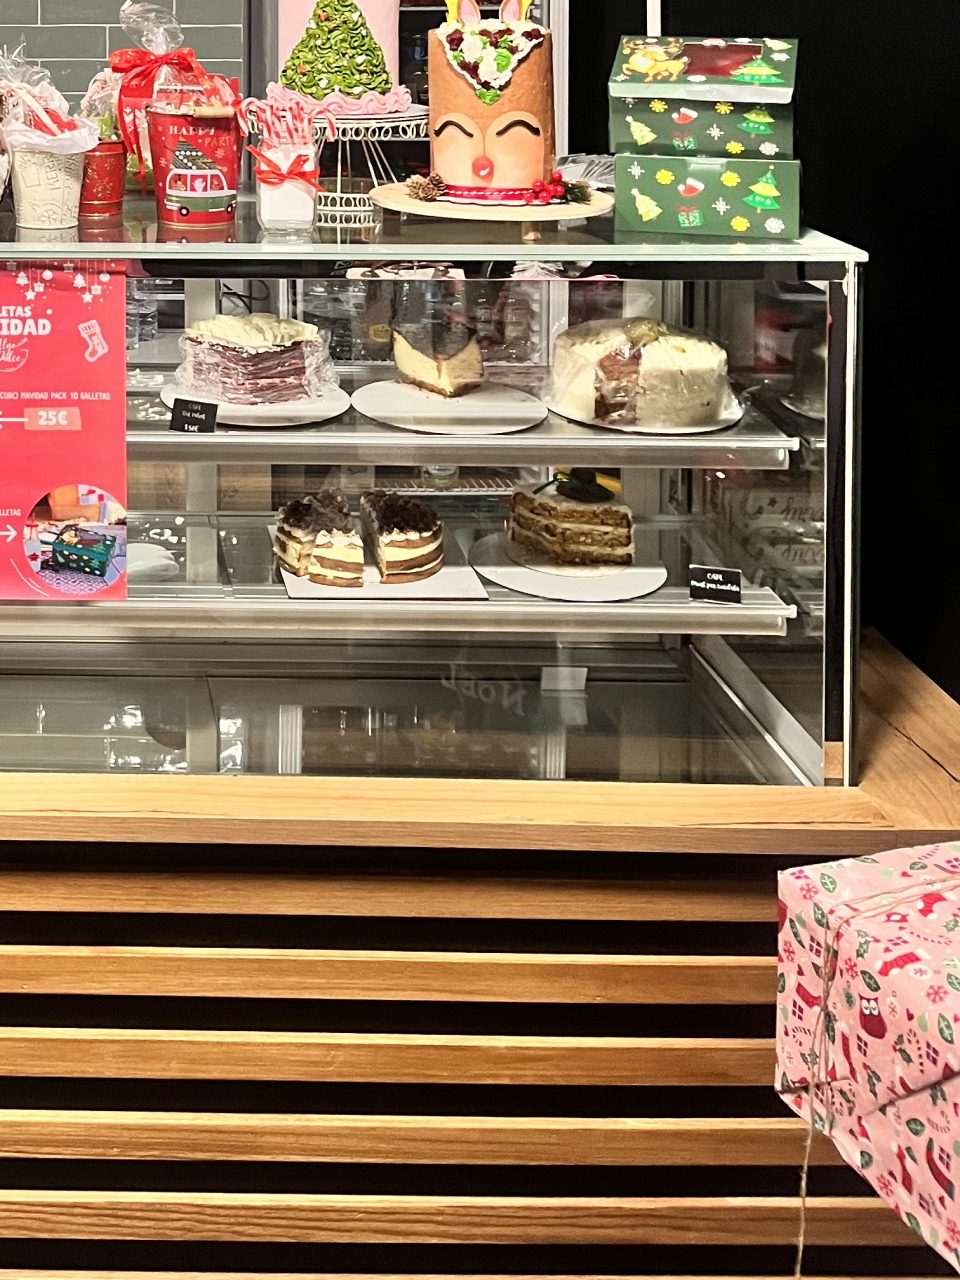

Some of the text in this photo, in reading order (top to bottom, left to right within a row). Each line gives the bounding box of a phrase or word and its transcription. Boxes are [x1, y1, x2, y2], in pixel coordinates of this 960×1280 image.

[168, 125, 215, 136] HAPPY
[0, 391, 111, 401] CUBO NAVIDAD PACK 10 GALLETAS
[38, 410, 68, 426] 25€
